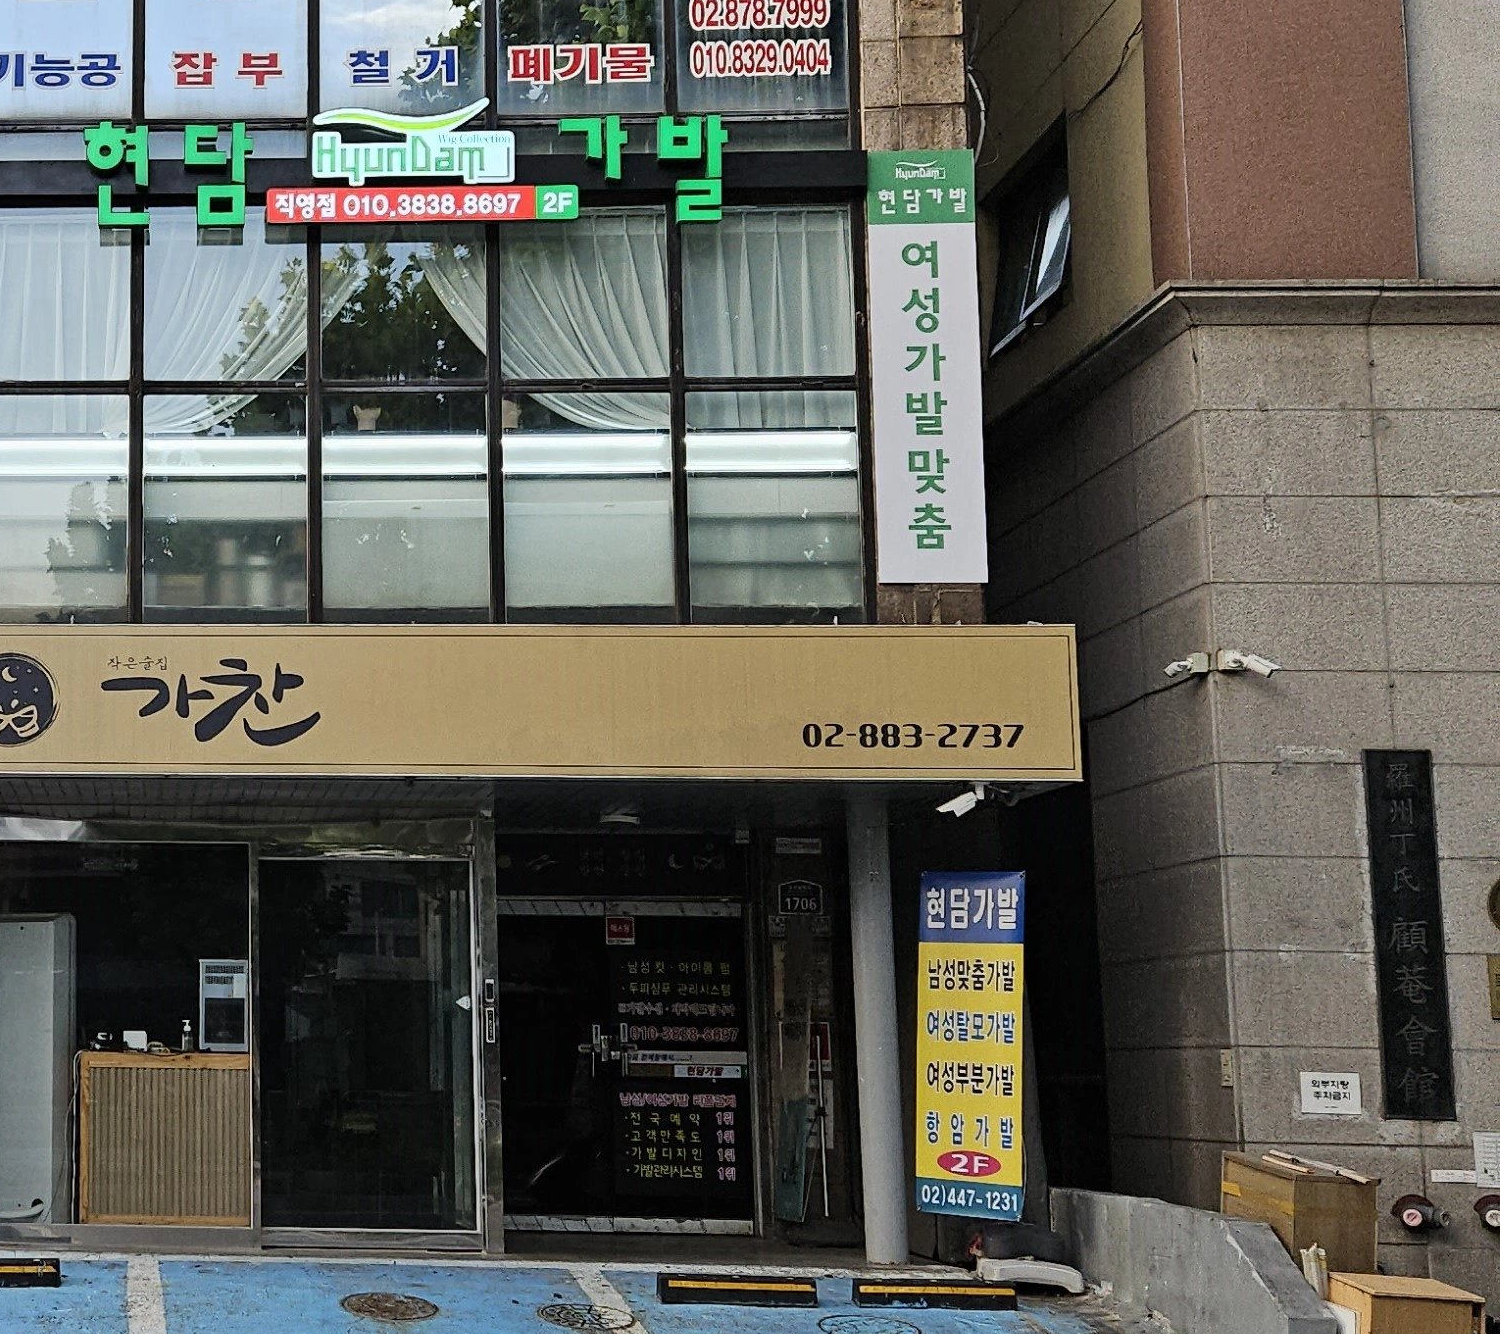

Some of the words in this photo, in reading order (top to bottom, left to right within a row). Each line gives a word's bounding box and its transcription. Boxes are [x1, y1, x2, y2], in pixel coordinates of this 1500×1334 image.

[171, 52, 283, 87] 잡부
[348, 47, 458, 85] 철거
[508, 44, 654, 84] 폐기물
[693, 42, 829, 75] 010.8329.0404
[437, 133, 457, 145] Wig
[459, 133, 511, 145] Collection
[84, 120, 255, 227] 현담
[558, 114, 730, 223] 가발
[317, 135, 486, 183] HyunDam
[895, 165, 941, 181] HyunDam
[274, 191, 337, 220] 직영점
[542, 192, 574, 213] 2F
[877, 186, 968, 215] 현담가발
[802, 723, 1025, 749] 02-883-2737
[784, 896, 818, 911] 1706
[925, 886, 1020, 932] 현담가발
[927, 957, 1016, 993] 남성맞춤가발
[676, 982, 732, 998] 관리시스템
[926, 1009, 1016, 1044] 여성탈모가발
[926, 1060, 1015, 1097] 여성부분가발
[1311, 1079, 1350, 1091] 외부차량
[1313, 1091, 1351, 1101] 주차금지
[630, 1111, 701, 1127] 전국예약
[925, 1111, 1015, 1150] 항암가발
[630, 1129, 702, 1144] 고객만족도
[631, 1146, 703, 1162] 가발디자인
[949, 1155, 990, 1176] 2F
[921, 1183, 1019, 1213] 02)447-1231
